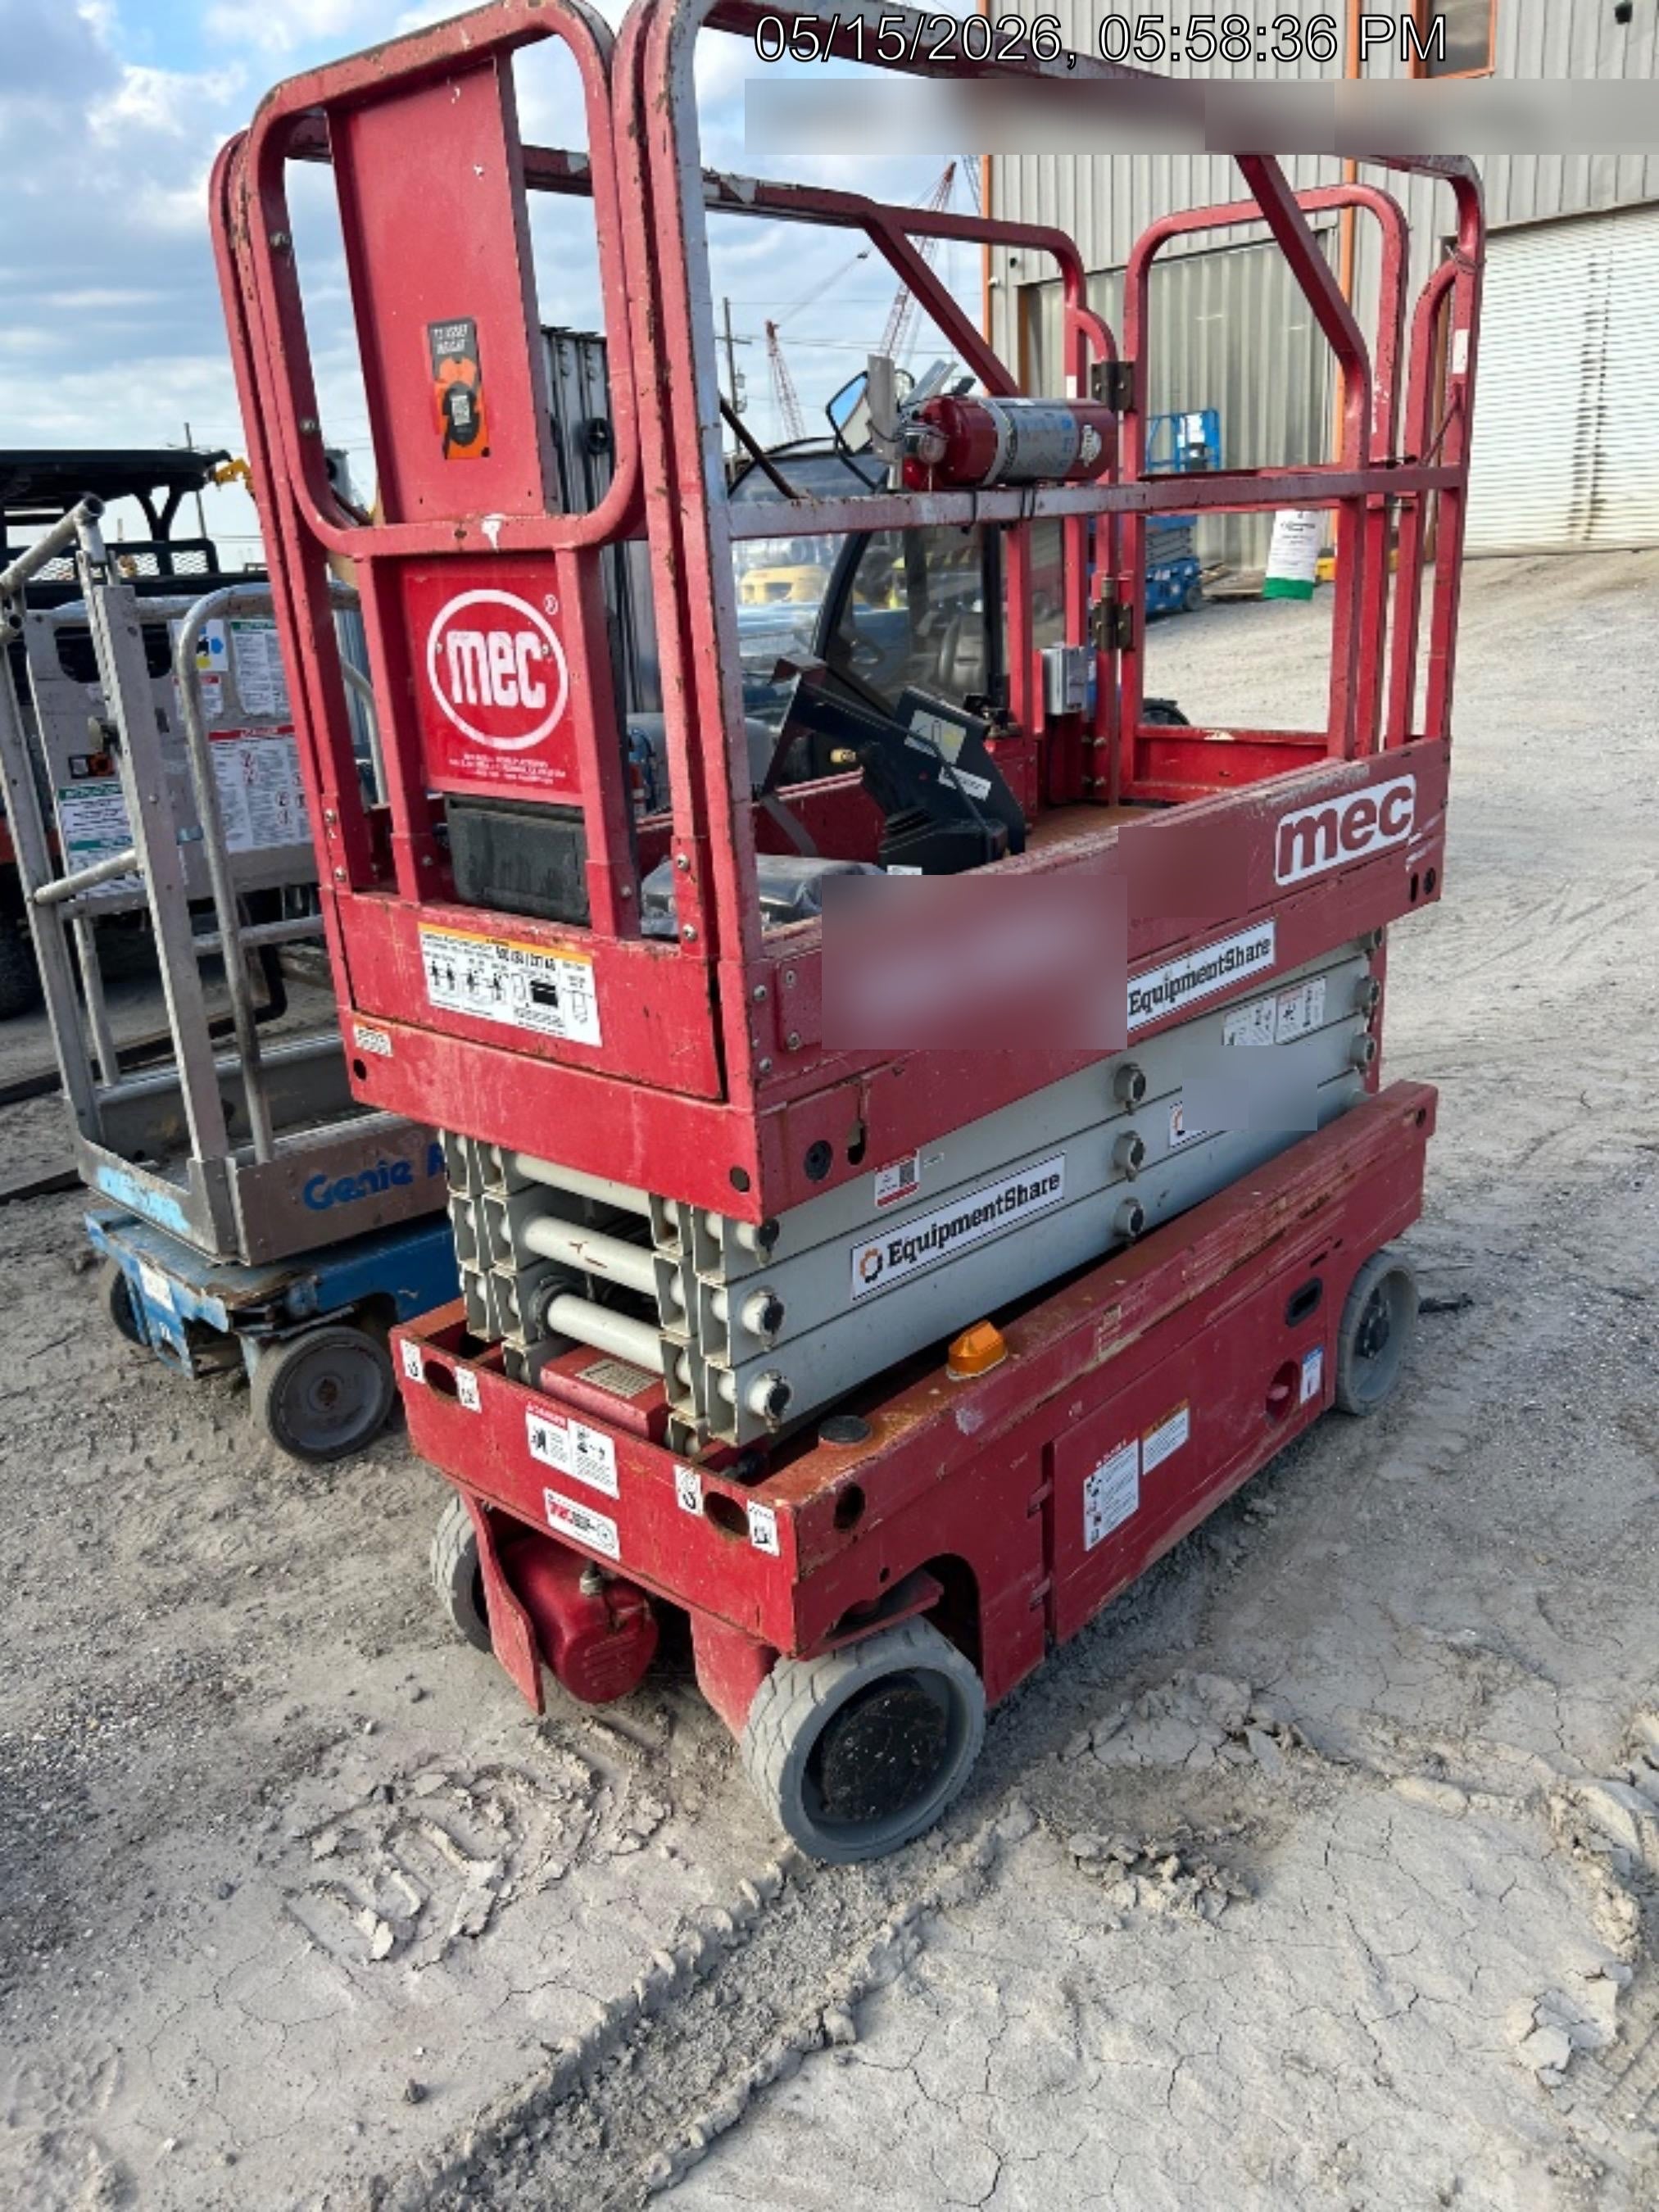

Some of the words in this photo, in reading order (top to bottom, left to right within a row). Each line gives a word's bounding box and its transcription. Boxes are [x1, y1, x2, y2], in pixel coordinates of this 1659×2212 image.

[1278, 786, 1412, 878] mec
[1128, 937, 1271, 1015] EquipmentShare
[303, 1159, 413, 1210] Genie
[887, 1172, 1061, 1268] EquipmentShare
